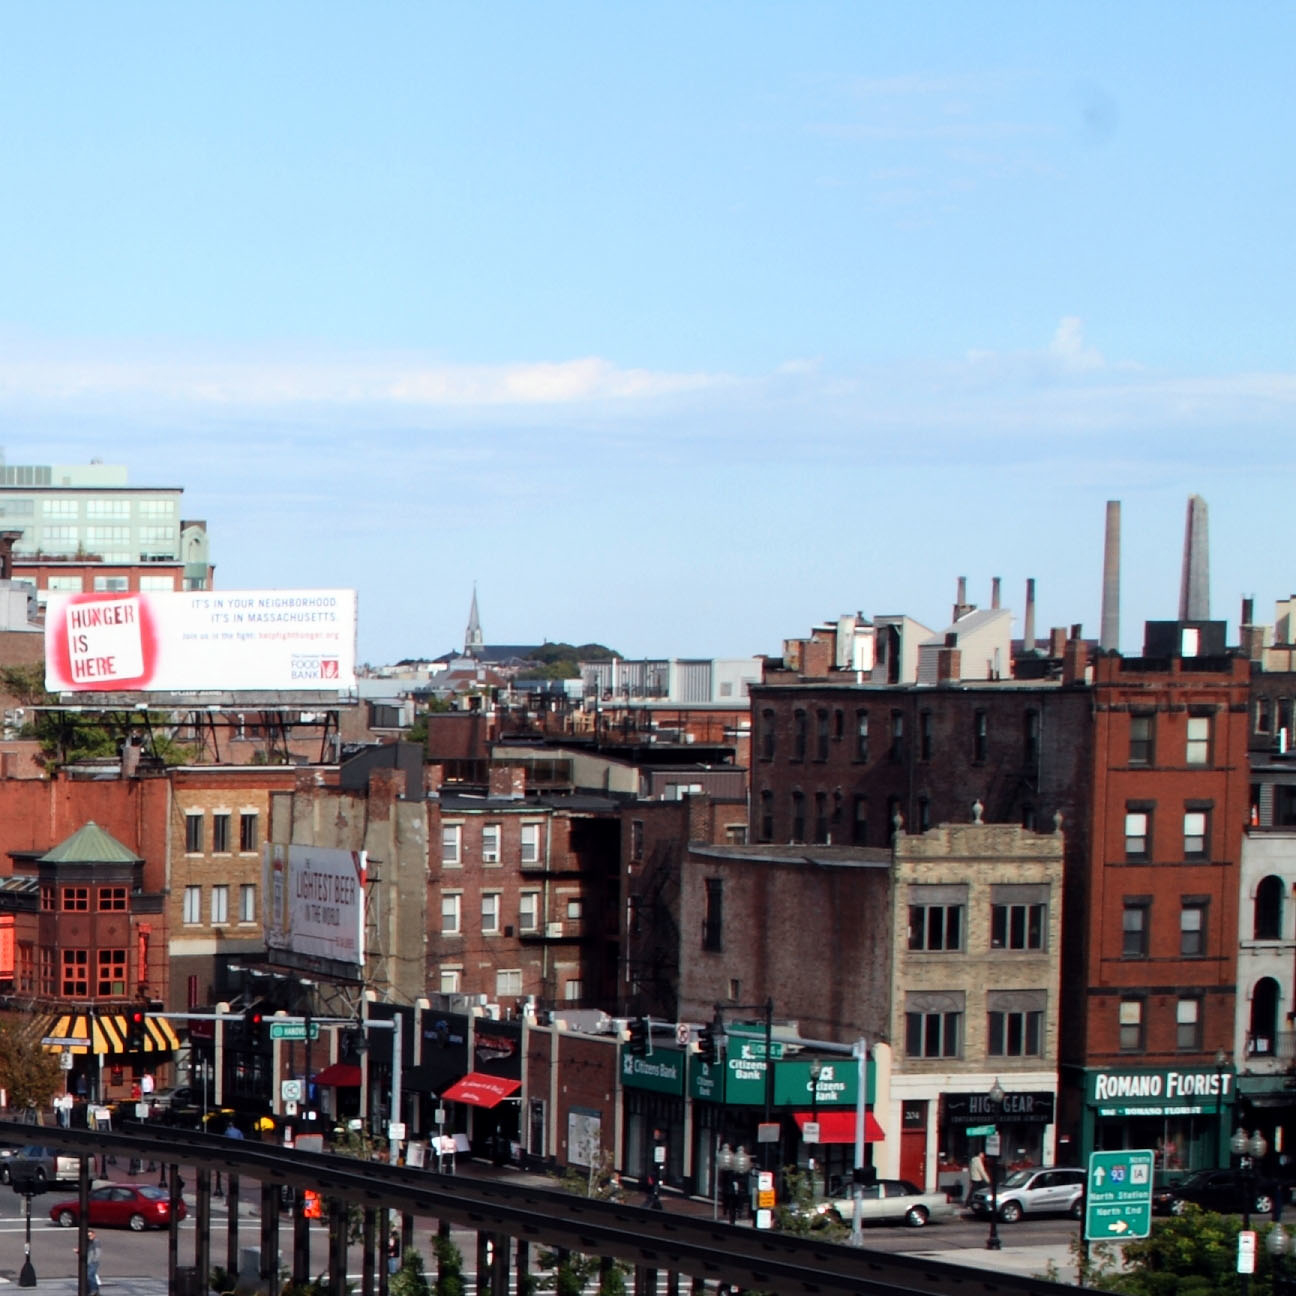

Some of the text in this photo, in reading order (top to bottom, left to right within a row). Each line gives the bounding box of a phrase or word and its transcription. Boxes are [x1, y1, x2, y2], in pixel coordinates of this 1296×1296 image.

[191, 599, 210, 609] IT'S
[213, 599, 224, 608] IN
[228, 599, 255, 608] YOUR
[71, 604, 135, 630] HUNGER
[211, 613, 229, 624] IT'S
[233, 612, 244, 623] IN
[73, 634, 89, 654] IS
[75, 656, 117, 679] HERE
[291, 659, 320, 669] FOOD
[291, 671, 319, 680] BANK
[296, 871, 356, 905] LIGHTEST BEER
[634, 1059, 677, 1080] Citizens Bank
[729, 1059, 768, 1071] Citizens
[735, 1069, 761, 1081] Bank
[807, 1081, 845, 1092] Ctizens
[1095, 1072, 1232, 1100] ROMANO FLORIST
[970, 1096, 1034, 1113] HIG GEAR
[1110, 1169, 1144, 1181] 93 1A
[1089, 1191, 1151, 1201] North Station
[1096, 1206, 1143, 1216] North End
